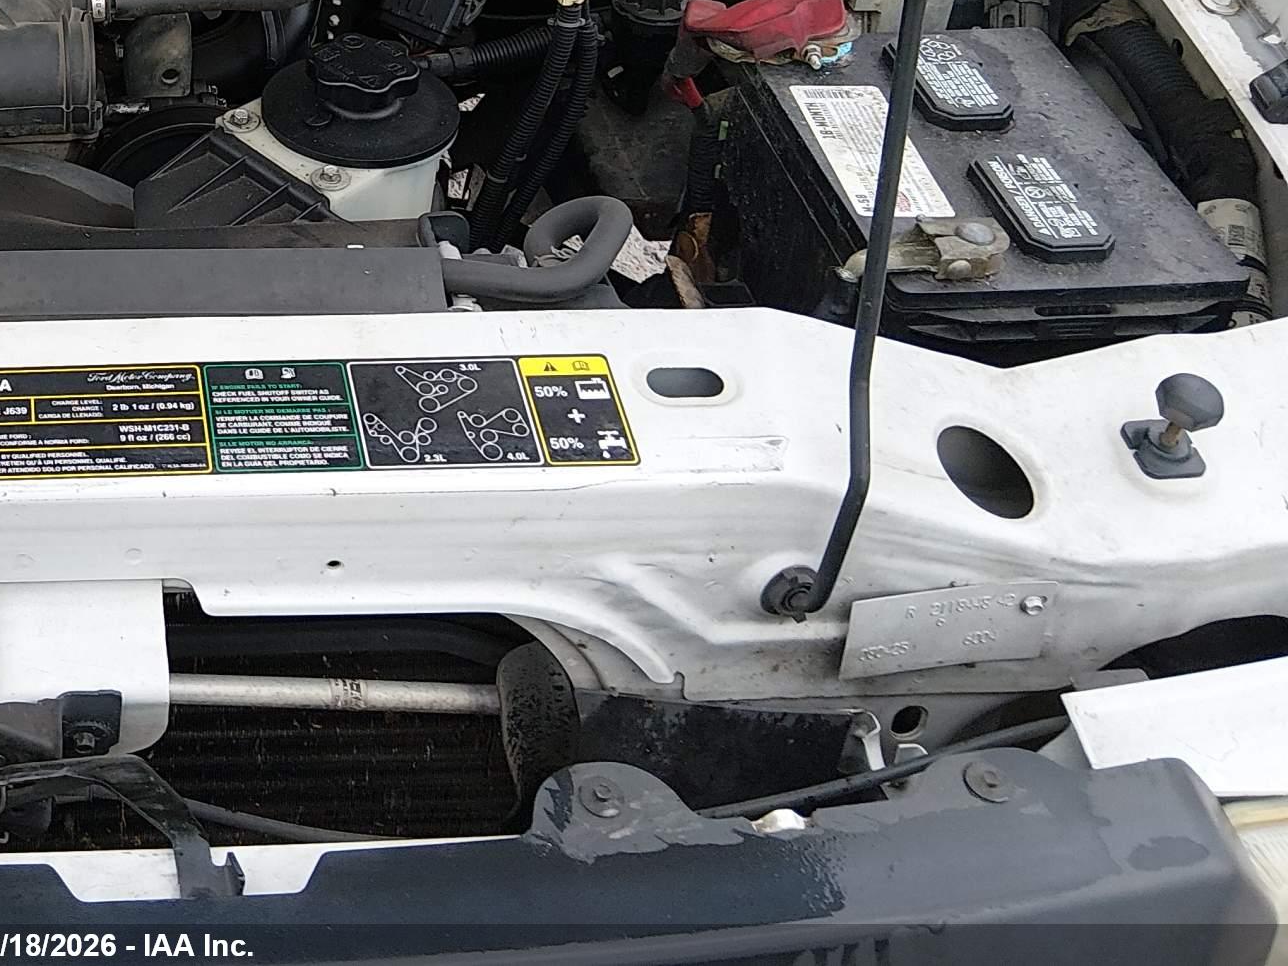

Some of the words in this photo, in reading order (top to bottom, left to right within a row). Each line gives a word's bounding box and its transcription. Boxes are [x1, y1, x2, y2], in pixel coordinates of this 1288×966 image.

[987, 160, 1017, 189] POISON
[1013, 195, 1046, 228] DANGER
[459, 364, 482, 372] 3.0L
[534, 386, 568, 398] 50%
[180, 402, 194, 410] kg)
[3, 407, 28, 415] J639
[119, 424, 190, 433] WSH-M1C231-B
[120, 434, 125, 442] 9
[127, 434, 134, 442] fl
[155, 434, 174, 442] (266
[549, 437, 584, 450] 50%
[424, 454, 447, 462] 2.3L
[506, 452, 530, 461] 4.0L
